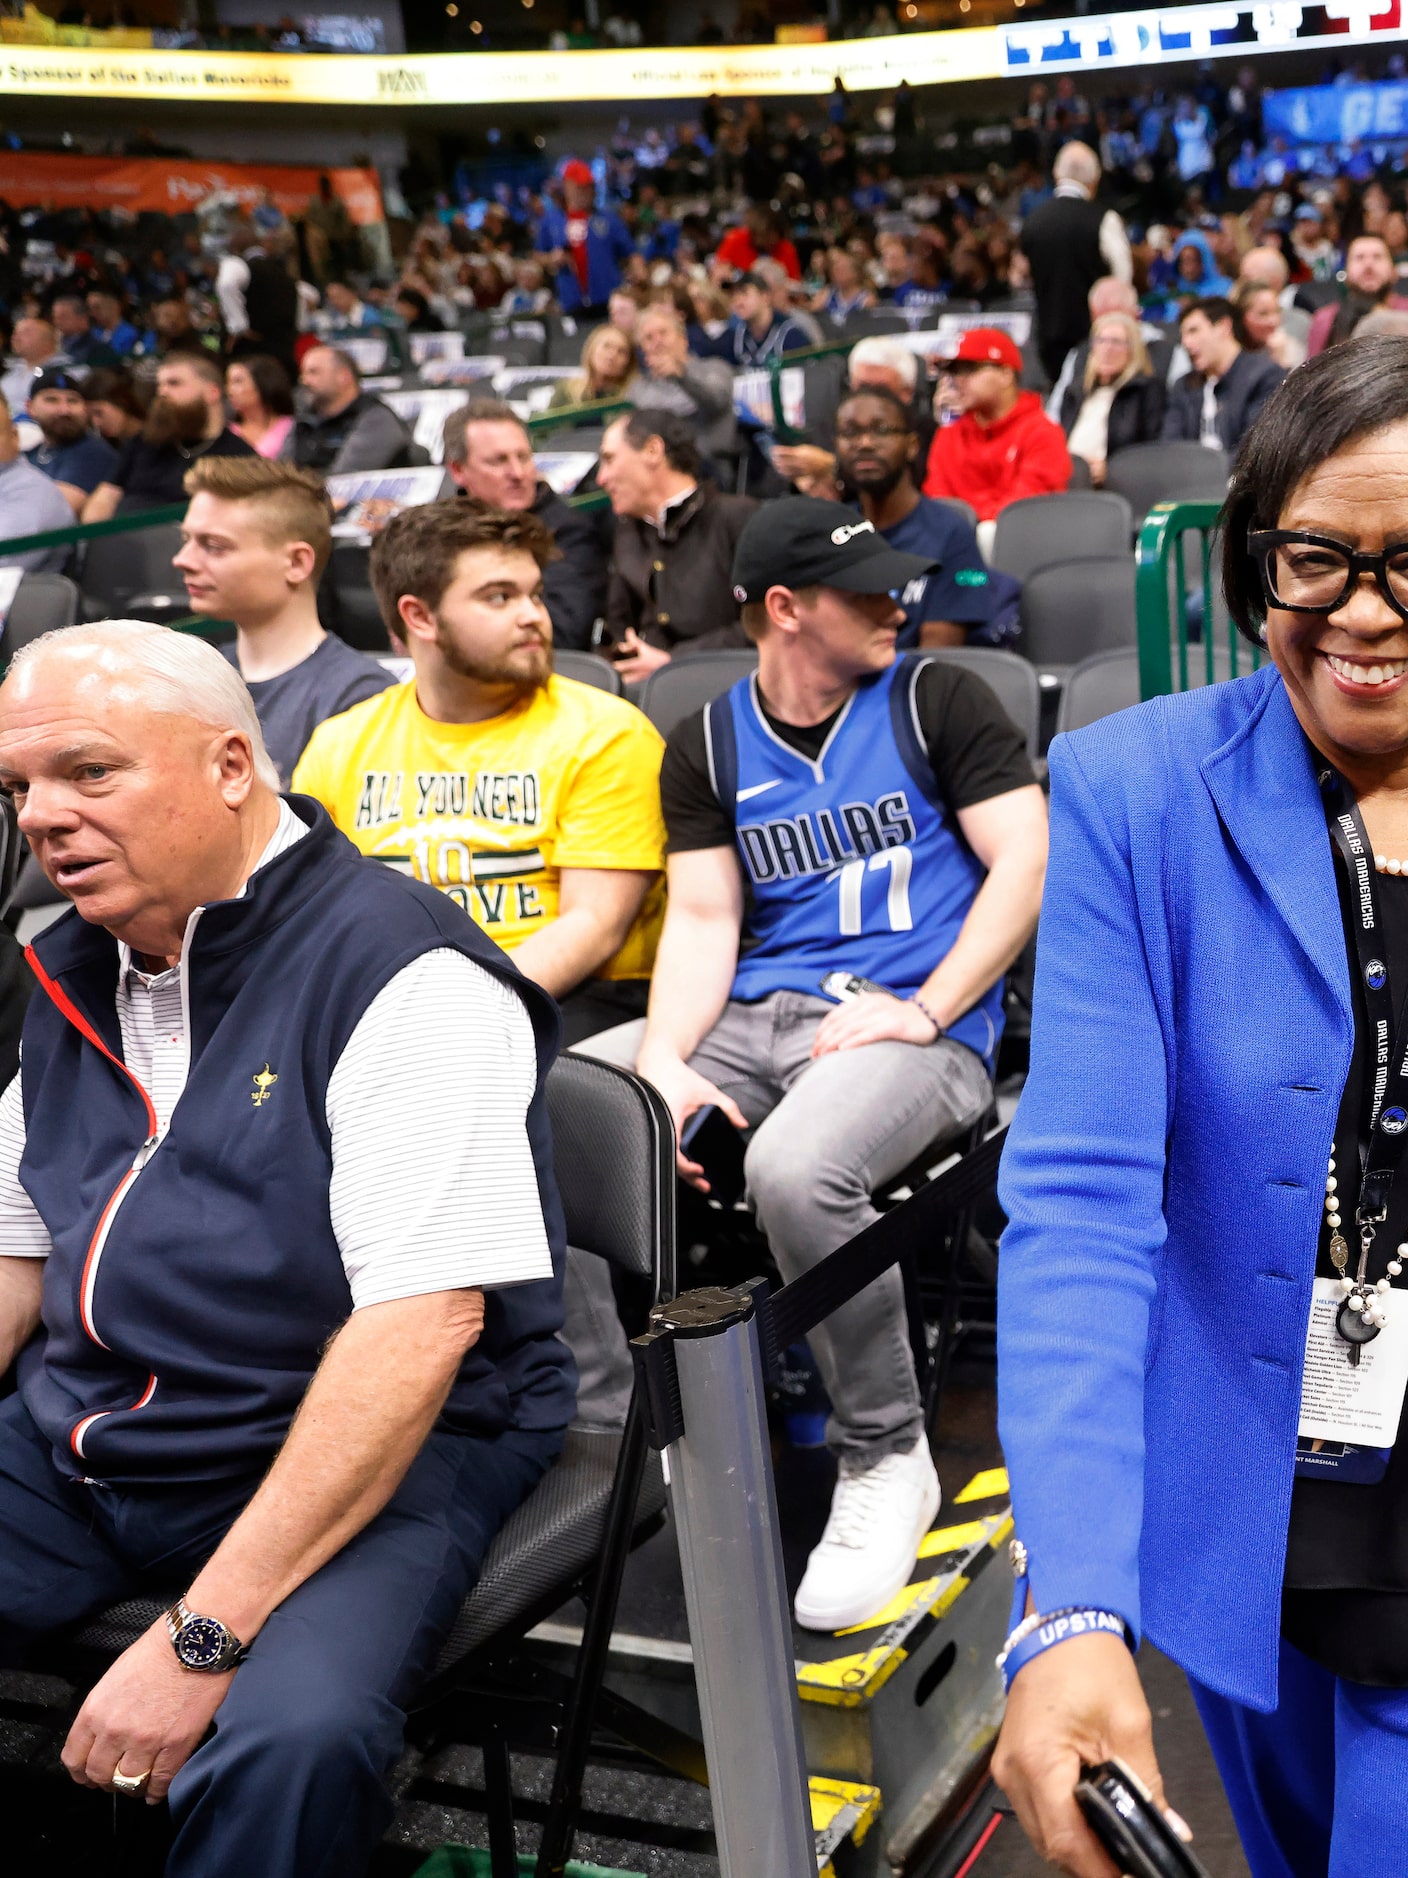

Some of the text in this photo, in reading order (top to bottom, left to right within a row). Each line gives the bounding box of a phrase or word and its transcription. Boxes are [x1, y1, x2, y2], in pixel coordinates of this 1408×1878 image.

[356, 773, 540, 828] ALL YOU NEED
[738, 791, 917, 884] DALLAS
[1337, 813, 1375, 930] DALLAS MAVERICKS
[1376, 1019, 1389, 1064] DALLAS
[1304, 1457, 1339, 1467] MARSHALL
